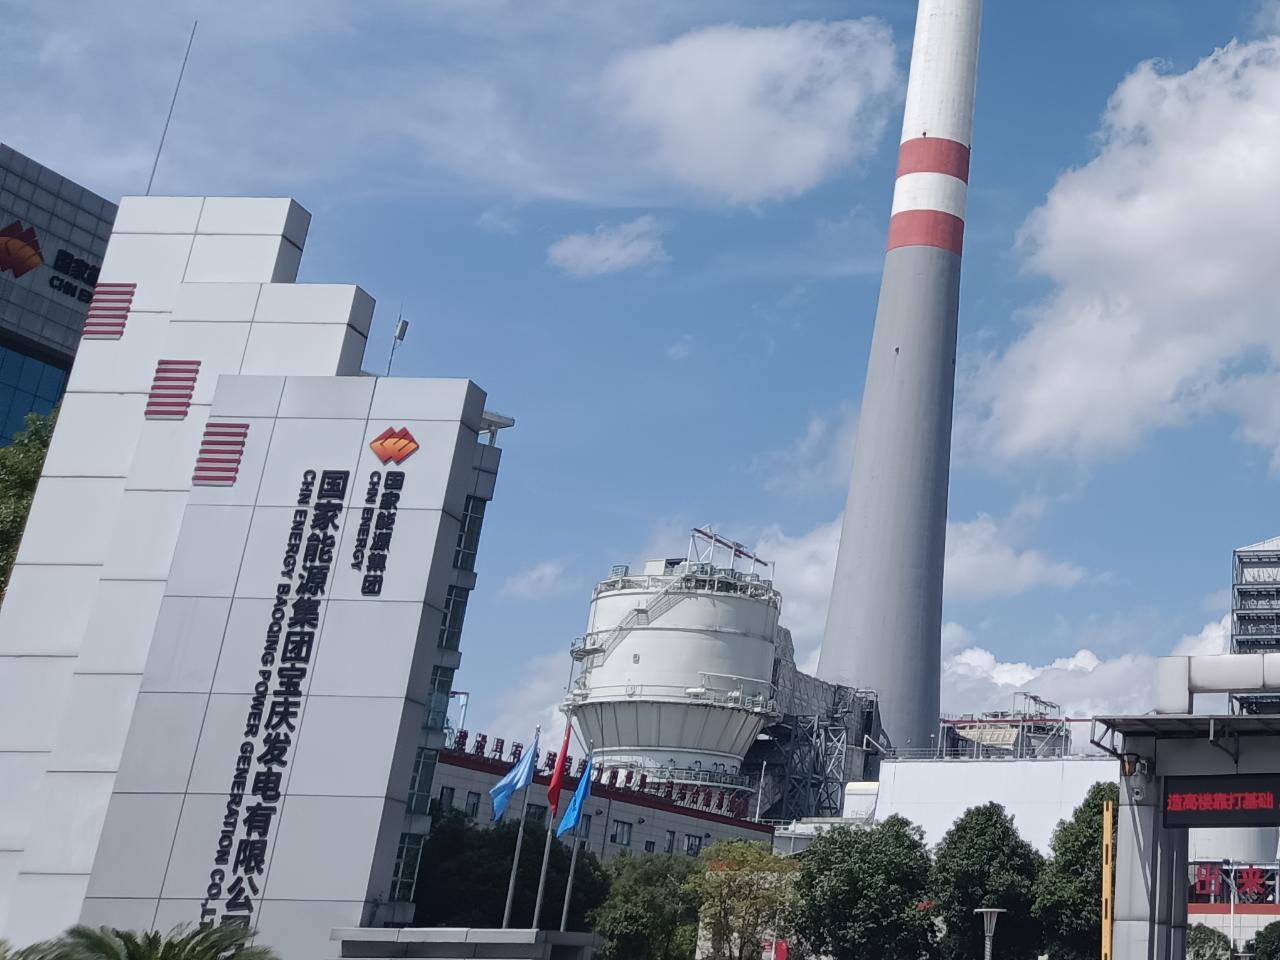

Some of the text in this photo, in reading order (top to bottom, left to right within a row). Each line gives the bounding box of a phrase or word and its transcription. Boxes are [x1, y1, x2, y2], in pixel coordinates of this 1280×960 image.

[298, 470, 317, 505] CHN
[351, 471, 381, 571] CHN ENERGY
[281, 509, 308, 580] ENERGY
[361, 471, 405, 596] 国家能源集团
[261, 583, 291, 666] BAOQING
[244, 669, 272, 737] POWER
[214, 741, 254, 865] GENERATION
